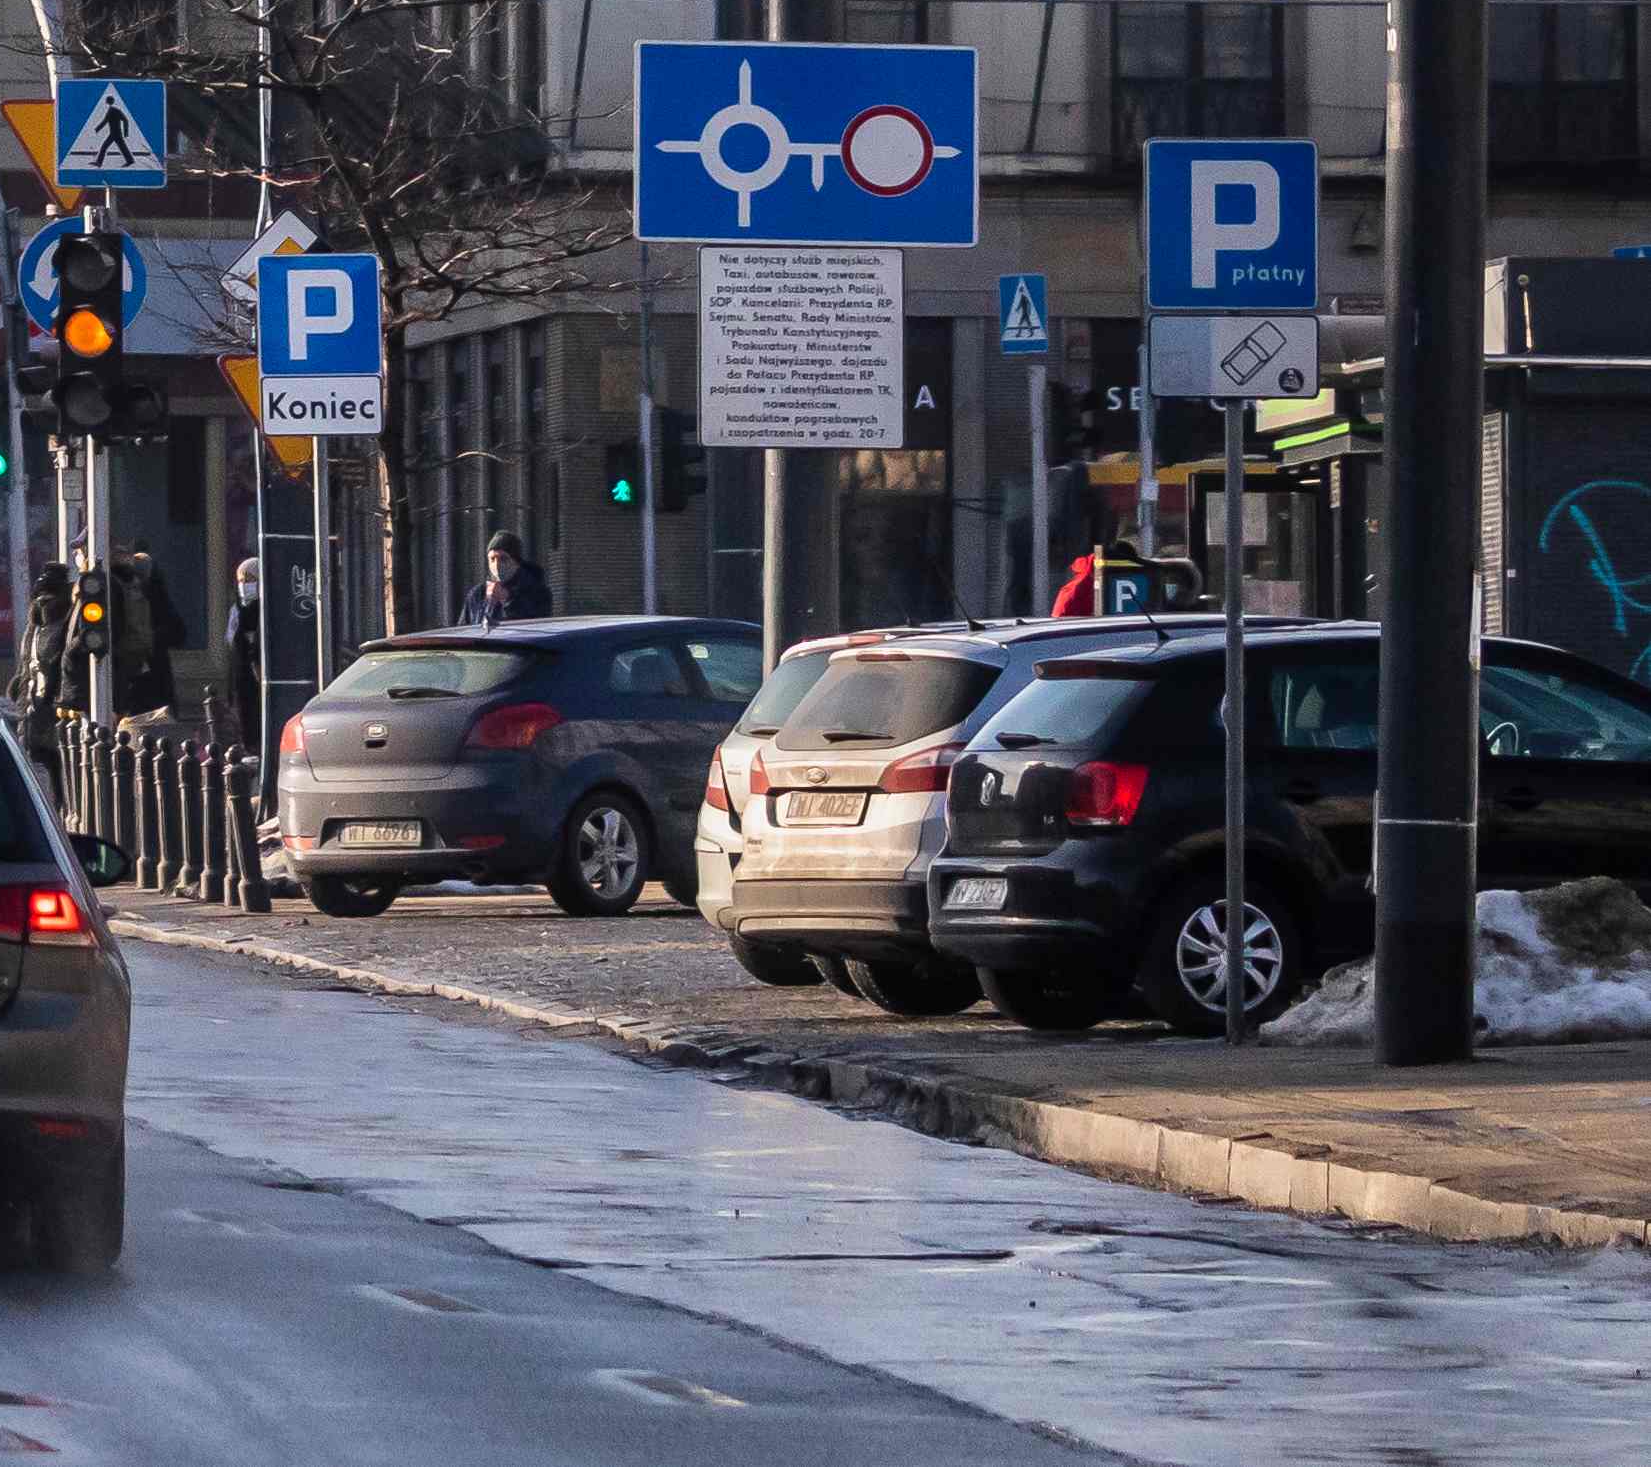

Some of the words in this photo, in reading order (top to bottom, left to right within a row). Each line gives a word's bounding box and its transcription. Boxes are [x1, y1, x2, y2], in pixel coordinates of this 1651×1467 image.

[1191, 159, 1281, 289] P
[1232, 262, 1306, 286] płatny
[287, 269, 355, 361] P
[268, 391, 375, 420] Koniec
